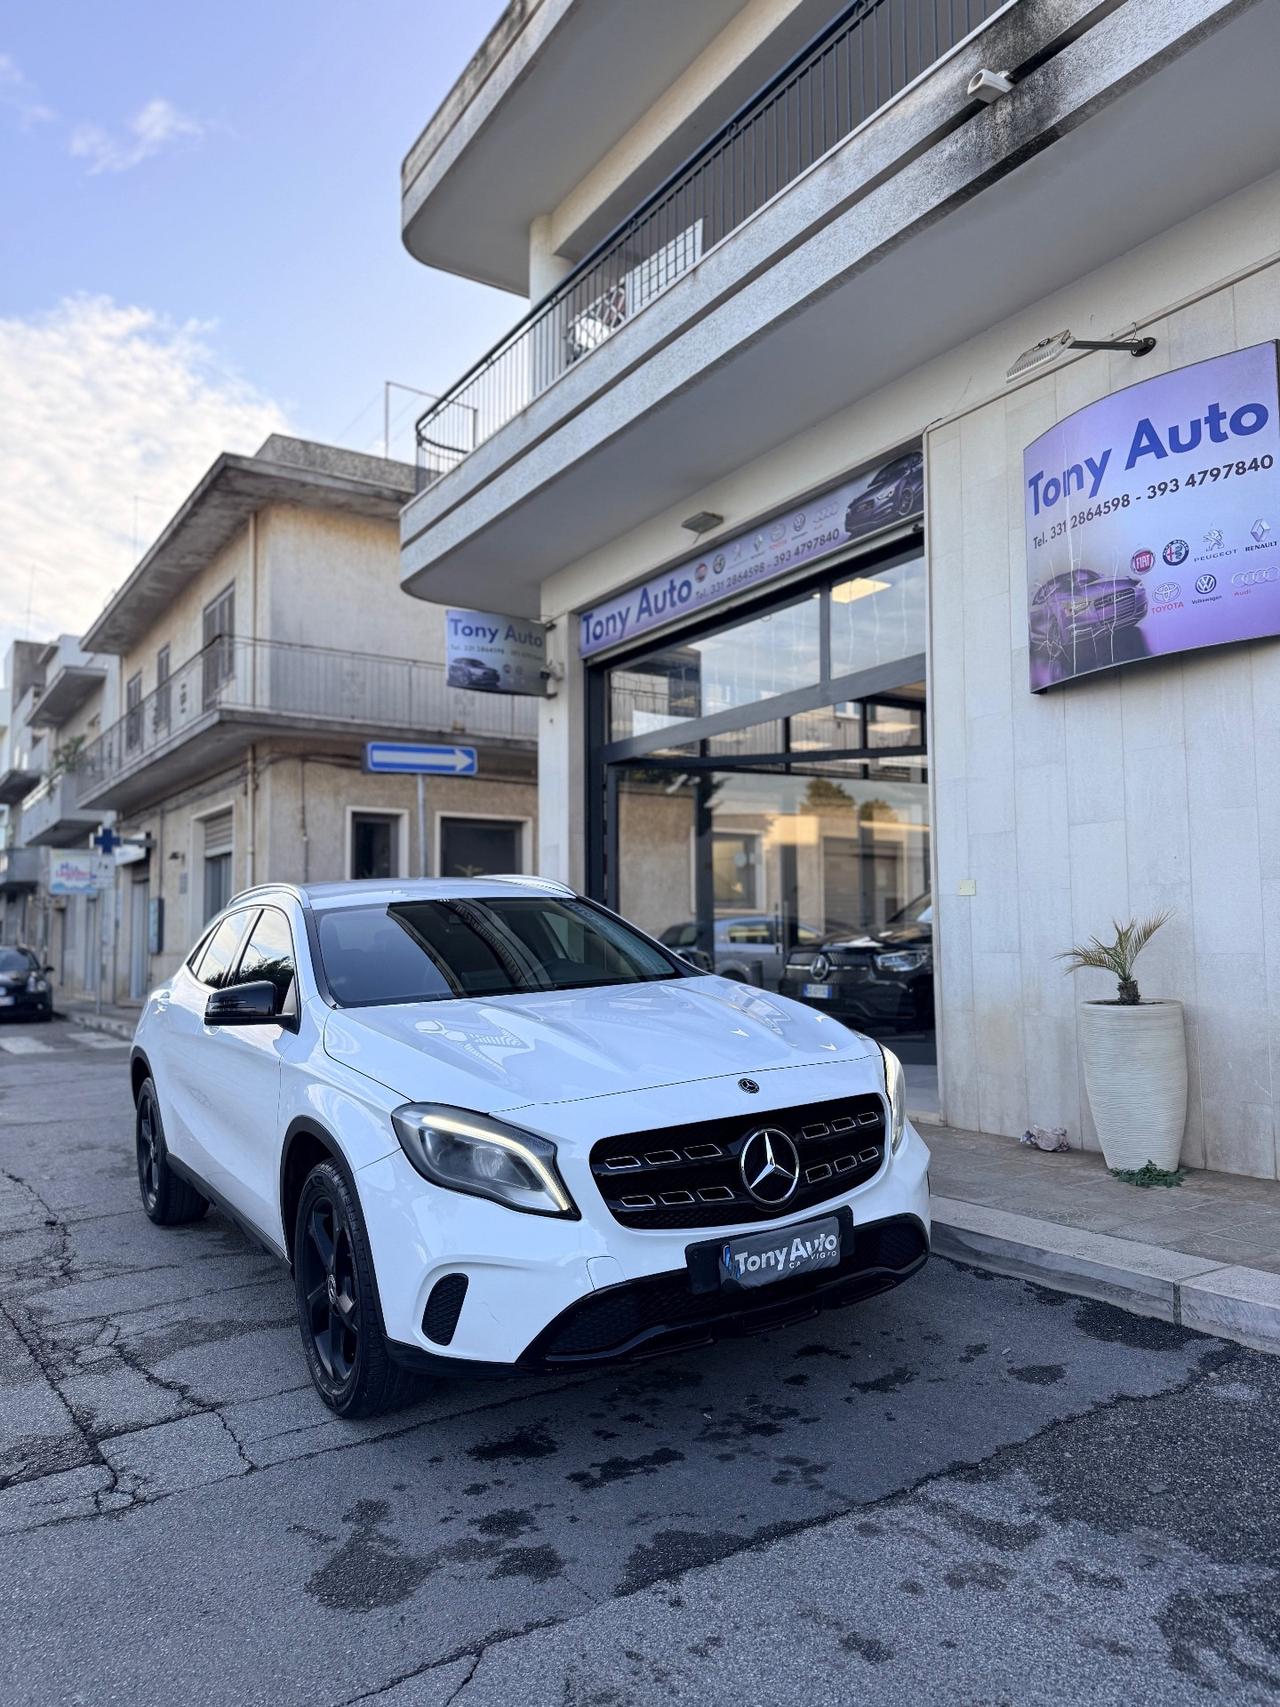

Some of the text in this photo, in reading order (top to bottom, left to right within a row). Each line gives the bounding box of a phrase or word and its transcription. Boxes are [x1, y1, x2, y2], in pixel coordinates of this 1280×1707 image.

[1028, 402, 1269, 516] Tony Auto
[1033, 531, 1048, 550] Tel.
[1050, 519, 1067, 540] 331
[1070, 493, 1131, 530] 2864598
[1147, 478, 1179, 500] 393
[1185, 454, 1274, 488] 4797840
[1194, 549, 1238, 562] PEUGEOT
[1245, 540, 1278, 552] RENAULT
[695, 588, 708, 600] Tel.
[710, 582, 725, 595] 331
[726, 562, 766, 588] 2864598
[773, 549, 791, 567] 393
[794, 528, 840, 557] 4797840
[1136, 552, 1152, 570] FIAT
[1234, 588, 1252, 597] Audi
[581, 577, 692, 645] Tony Auto
[1152, 601, 1184, 614] TOYOTA
[450, 618, 543, 648] Tony Auto
